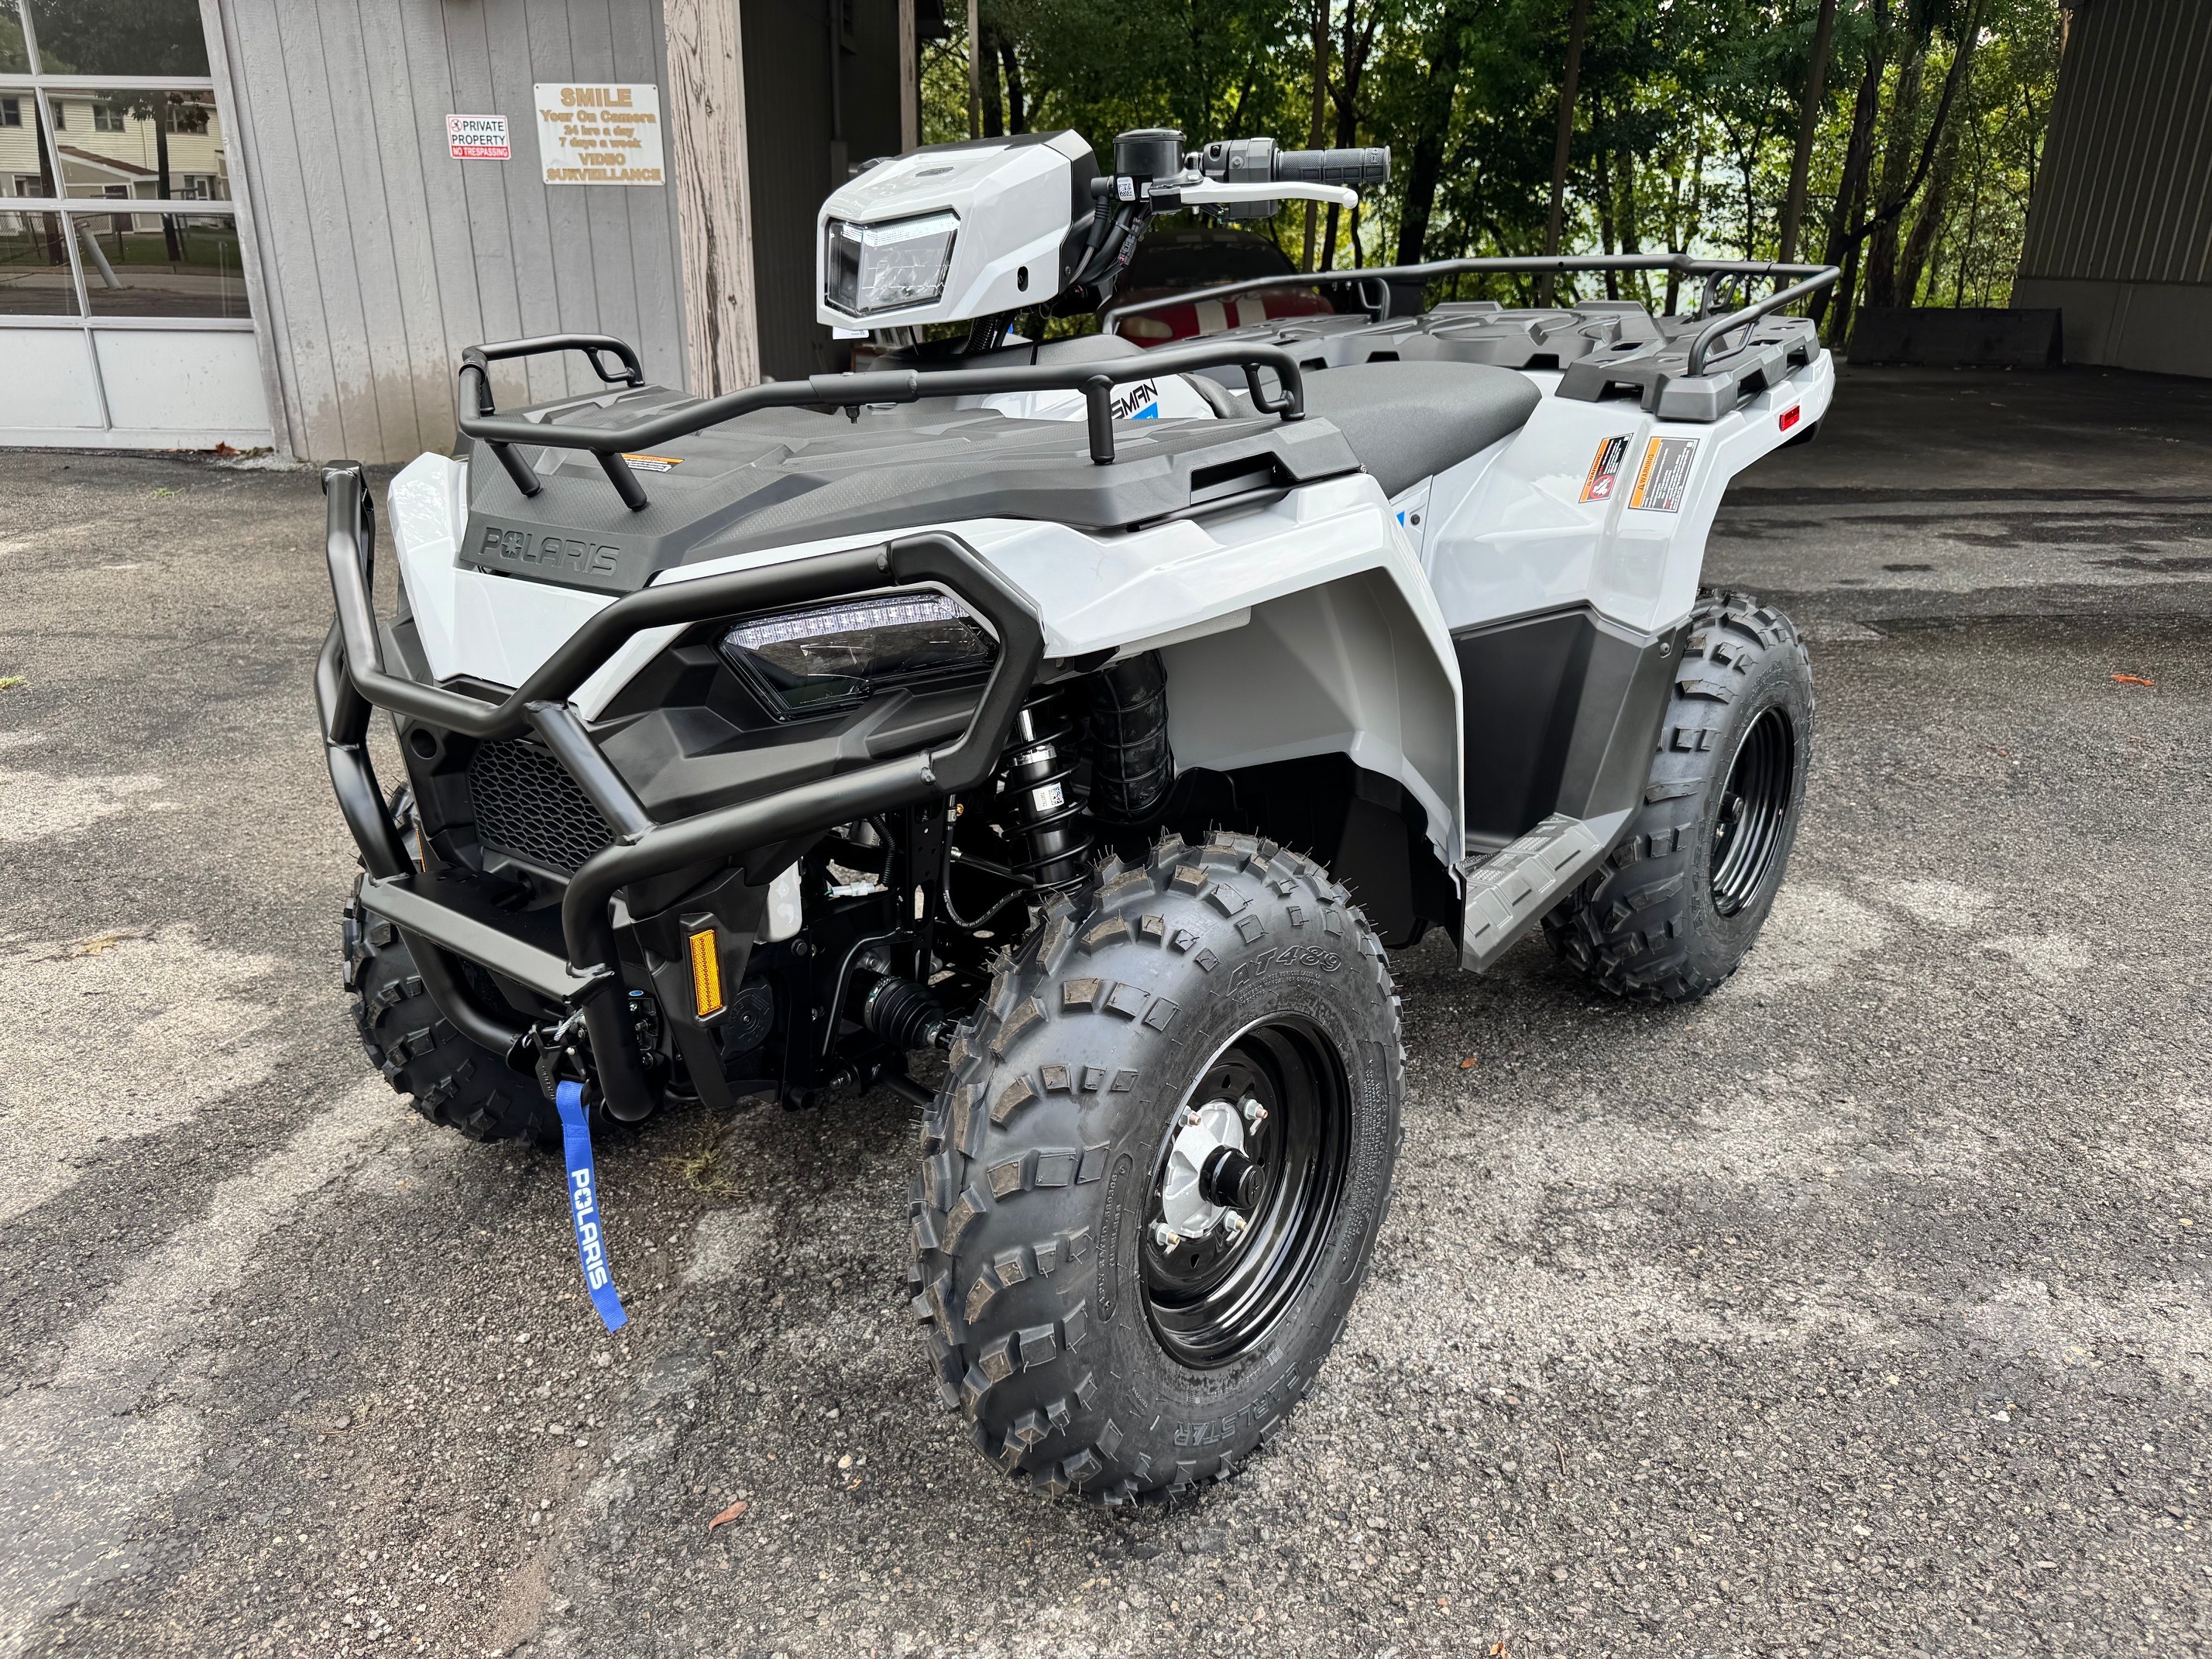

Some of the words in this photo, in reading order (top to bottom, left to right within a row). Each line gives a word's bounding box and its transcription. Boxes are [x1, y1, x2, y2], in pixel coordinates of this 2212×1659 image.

[561, 88, 633, 107] SMILE
[539, 109, 574, 122] Your
[577, 110, 597, 122] On
[600, 110, 656, 123] Camera
[463, 121, 504, 132] PRIVATE
[564, 125, 579, 136] 24
[581, 125, 600, 136] hrs
[613, 125, 634, 138] day
[452, 135, 505, 146] PROPERTY
[558, 137, 566, 147] 7
[569, 138, 597, 149] days
[610, 138, 642, 148] week
[453, 147, 462, 156] NO
[463, 147, 508, 156] TRESPASSING
[579, 153, 626, 166] VIDEO
[547, 168, 661, 181] SURVEILLANCE
[1589, 453, 1602, 482] WARNING
[1640, 454, 1654, 486] WARNING
[478, 527, 620, 577] POLARIS
[571, 1168, 608, 1290] POLARIS
[1173, 1362, 1300, 1446] CARLSTAR
